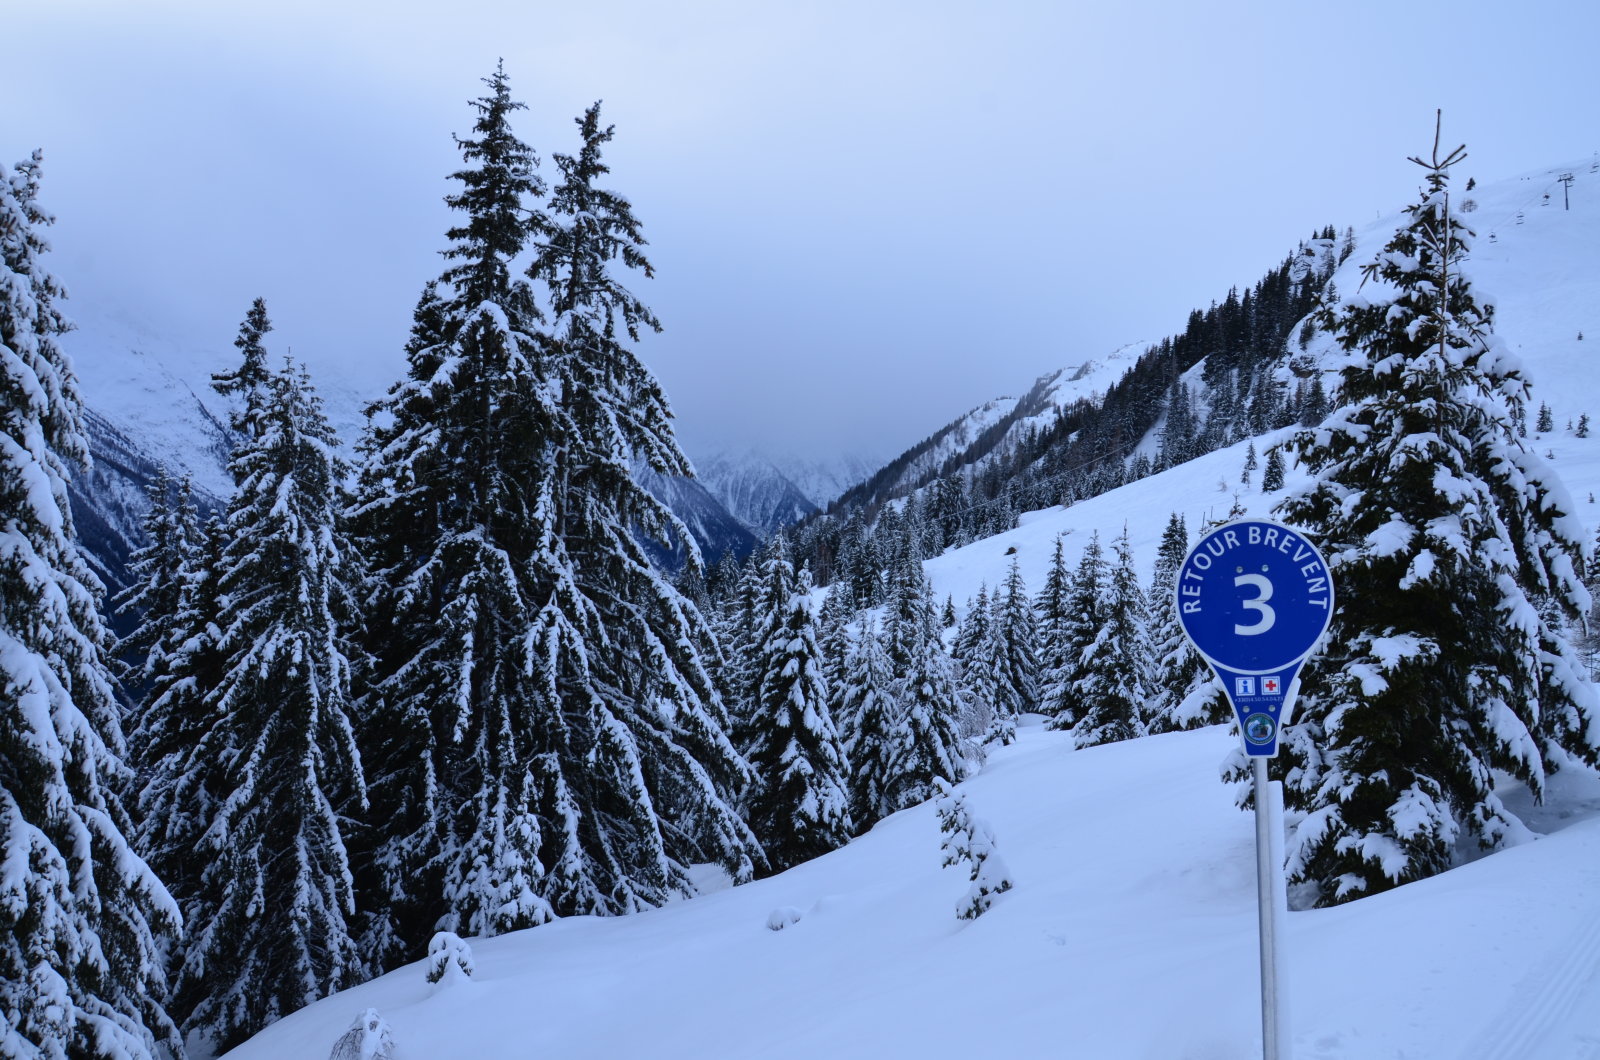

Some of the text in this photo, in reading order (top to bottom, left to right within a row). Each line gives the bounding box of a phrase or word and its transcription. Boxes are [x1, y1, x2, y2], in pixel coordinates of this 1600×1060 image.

[1182, 526, 1328, 614] RETOUR BREVENT
[1234, 573, 1276, 636] 3
